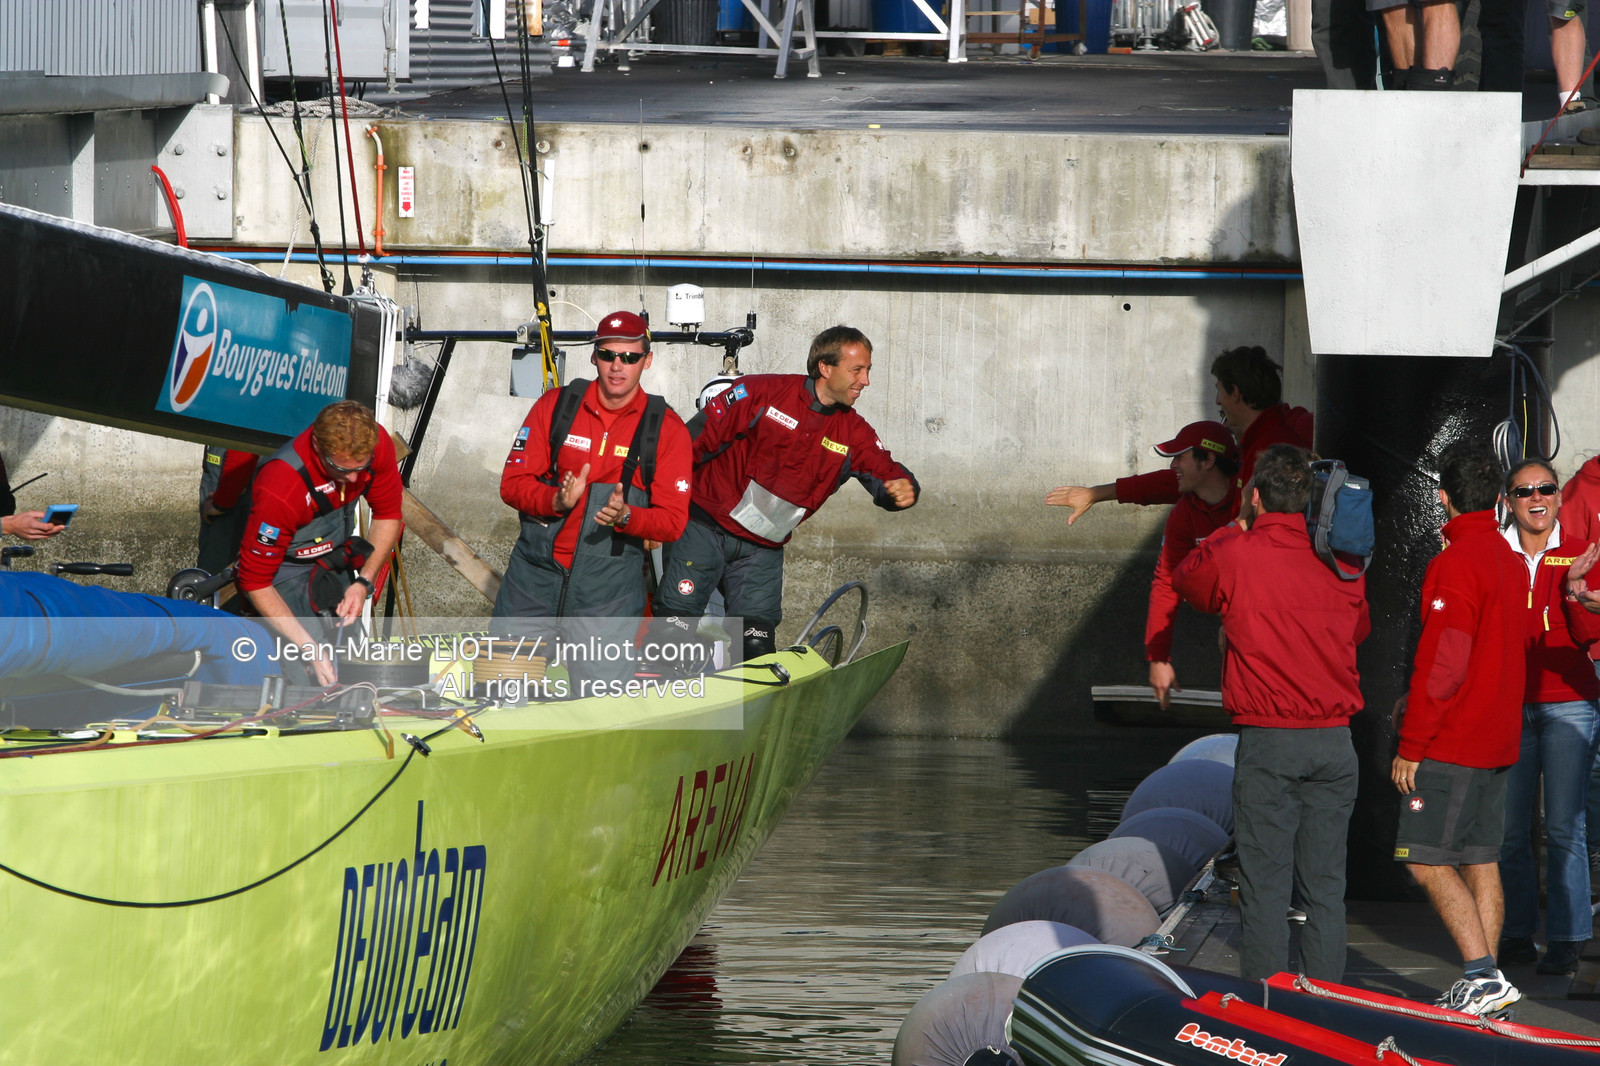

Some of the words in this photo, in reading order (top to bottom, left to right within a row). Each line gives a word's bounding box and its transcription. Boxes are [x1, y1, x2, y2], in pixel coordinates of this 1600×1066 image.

[212, 328, 298, 397] Bouygues
[295, 348, 347, 398] Telecom
[769, 409, 778, 418] LE
[780, 414, 796, 427] DEFI
[822, 438, 847, 453] AREVA
[310, 543, 331, 554] DEFI
[652, 752, 755, 887] AREVA
[1174, 1022, 1288, 1066] Bombard
